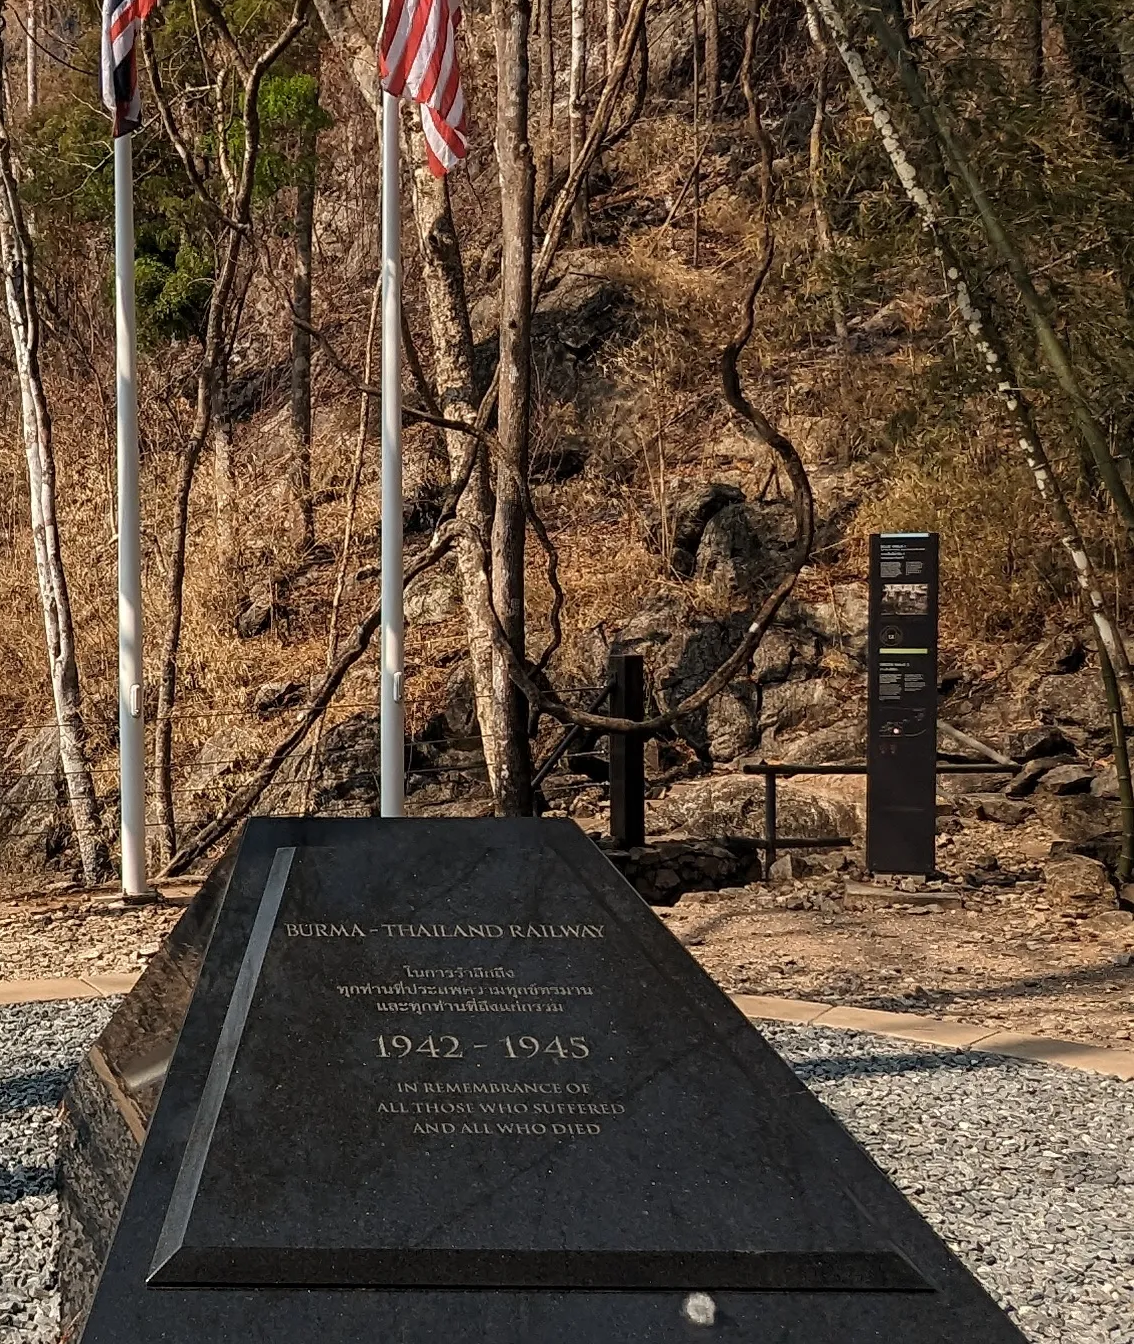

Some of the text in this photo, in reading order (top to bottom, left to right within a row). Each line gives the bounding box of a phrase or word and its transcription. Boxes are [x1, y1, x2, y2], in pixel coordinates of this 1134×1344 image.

[284, 923, 366, 937] BURMA
[381, 923, 504, 937] THAILAND
[508, 923, 604, 937] RAILWAY
[372, 1034, 463, 1058] 1942
[498, 1035, 590, 1059] 1945
[397, 1083, 592, 1094] IN REMEMBRANCE OF
[377, 1102, 625, 1114] ALL THOSE WHO SUFFERED
[413, 1122, 601, 1135] AND ALL WHO DIED
